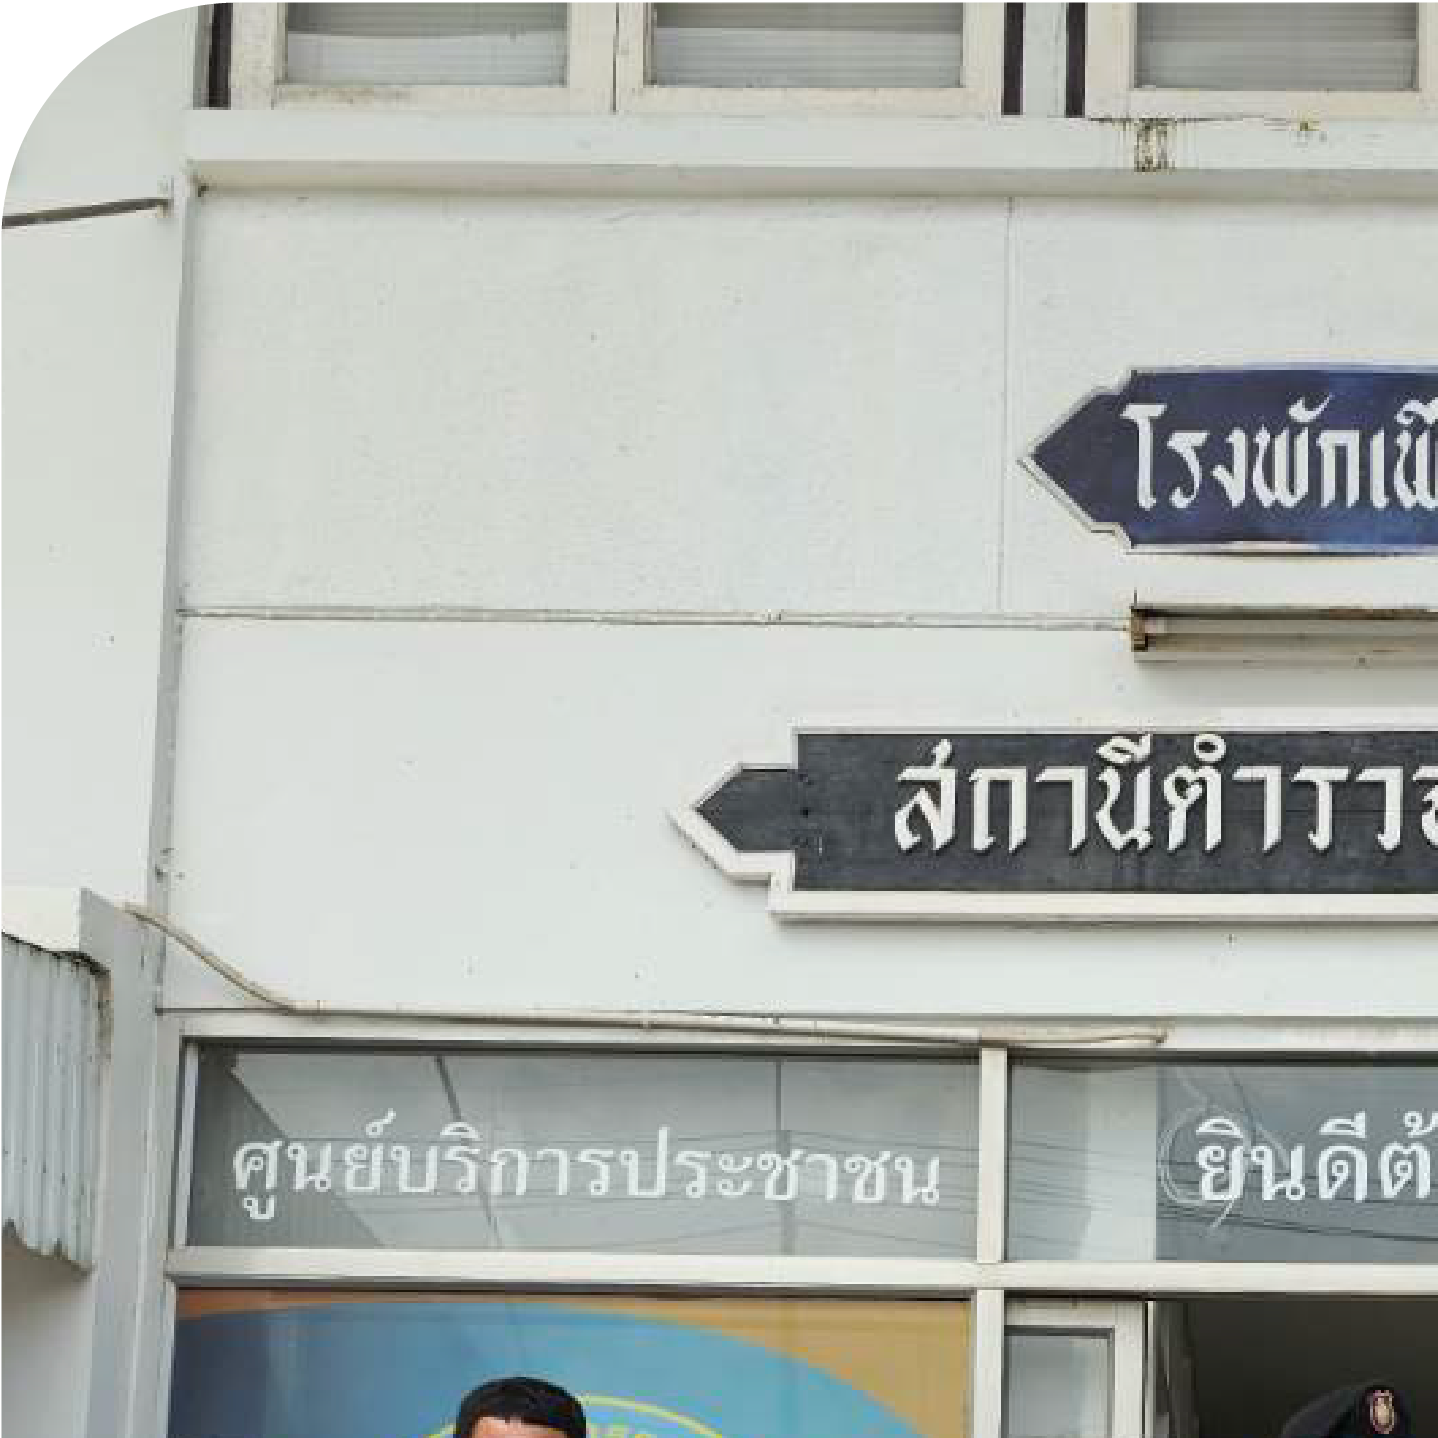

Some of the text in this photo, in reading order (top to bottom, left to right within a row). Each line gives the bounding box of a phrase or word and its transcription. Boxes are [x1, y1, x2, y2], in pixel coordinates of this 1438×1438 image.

[231, 1108, 942, 1221] ศูนย์บริการประชาชน
